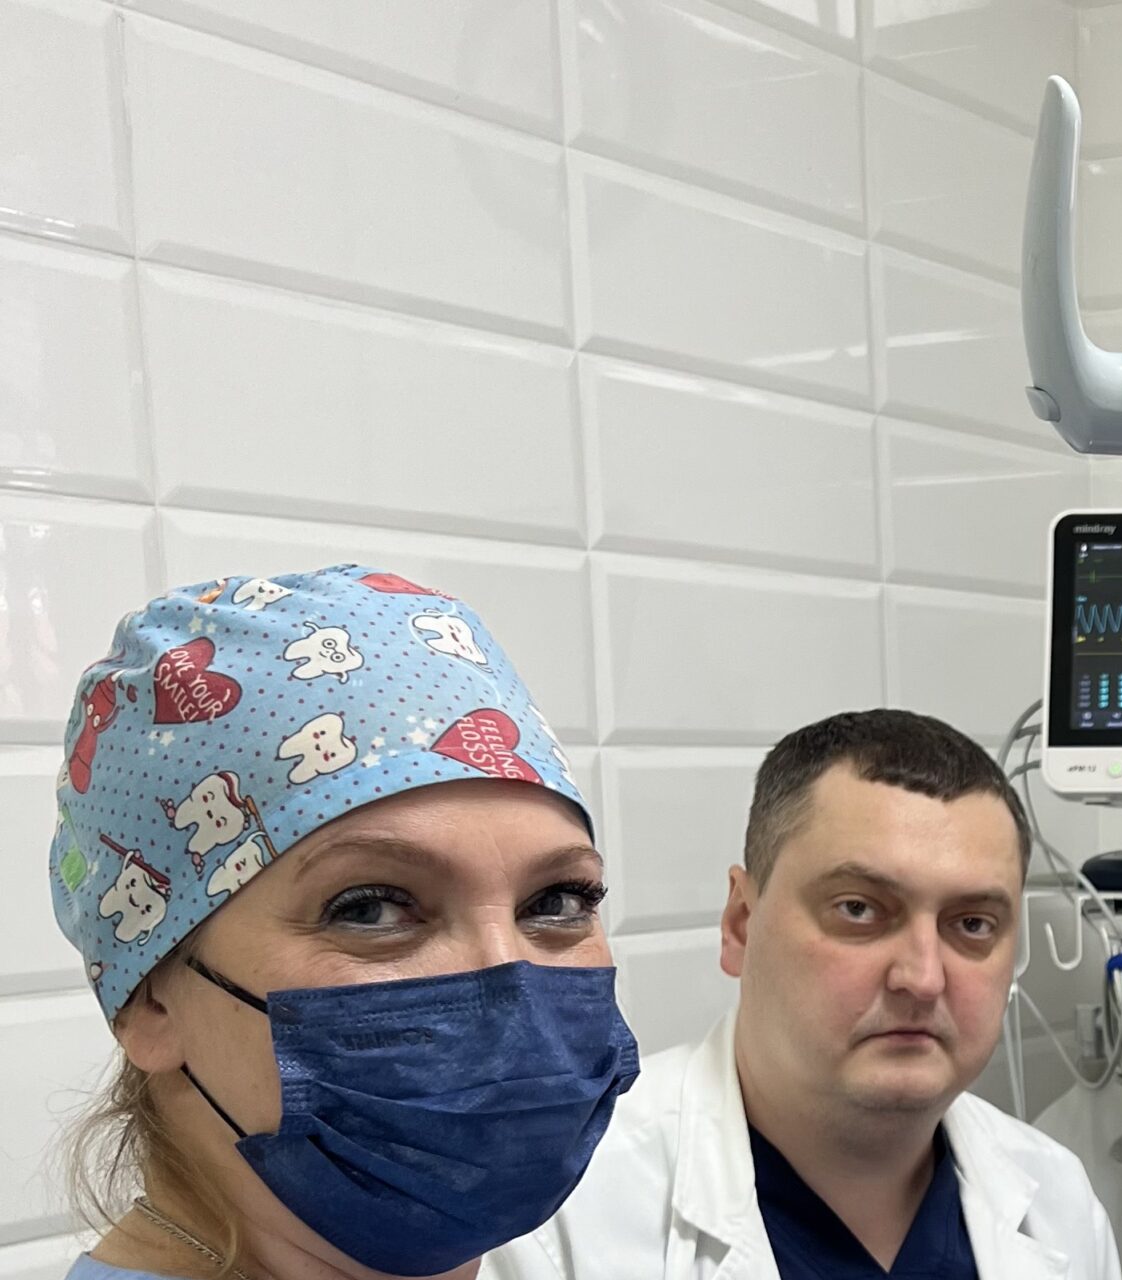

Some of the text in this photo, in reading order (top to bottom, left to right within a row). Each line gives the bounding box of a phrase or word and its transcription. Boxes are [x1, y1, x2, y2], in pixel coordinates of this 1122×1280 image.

[1073, 524, 1117, 535] mindray
[188, 673, 223, 721] YOUR
[478, 718, 524, 779] FEELING
